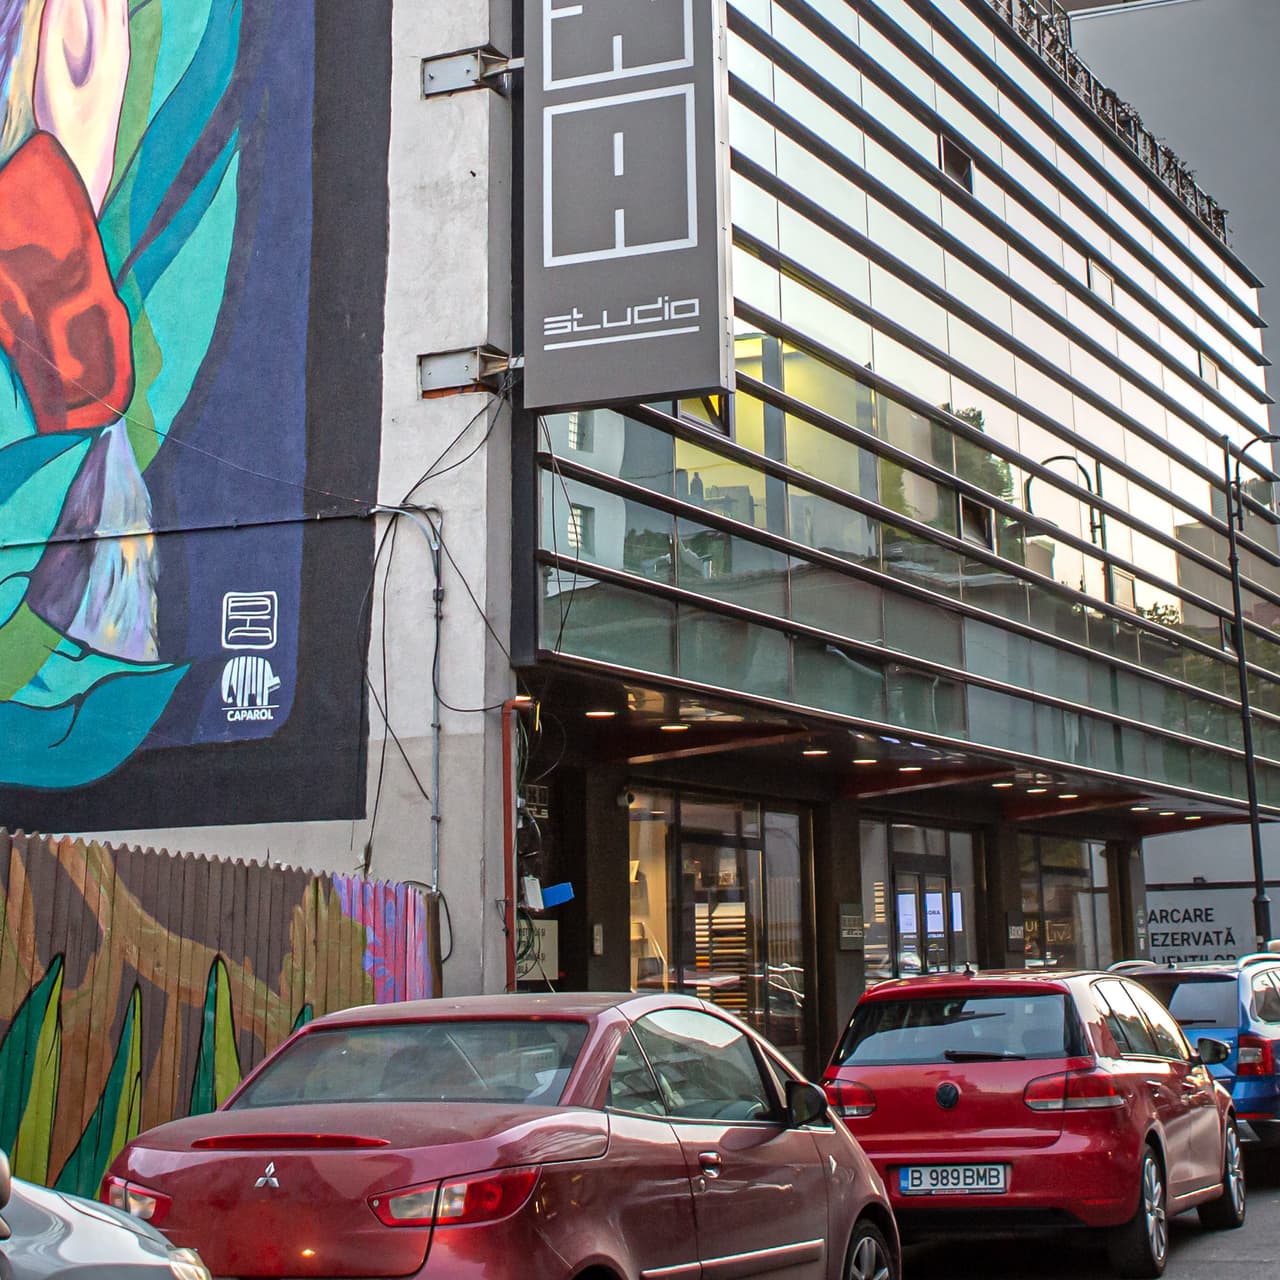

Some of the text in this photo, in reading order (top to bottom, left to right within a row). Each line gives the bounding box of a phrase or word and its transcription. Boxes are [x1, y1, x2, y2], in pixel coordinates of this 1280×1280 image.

[543, 295, 700, 336] studio
[226, 708, 274, 722] CAPAROL
[1148, 907, 1215, 924] ARCARE
[1150, 926, 1236, 948] EZERVATĂ
[910, 1167, 1001, 1188] B 989 BMB
